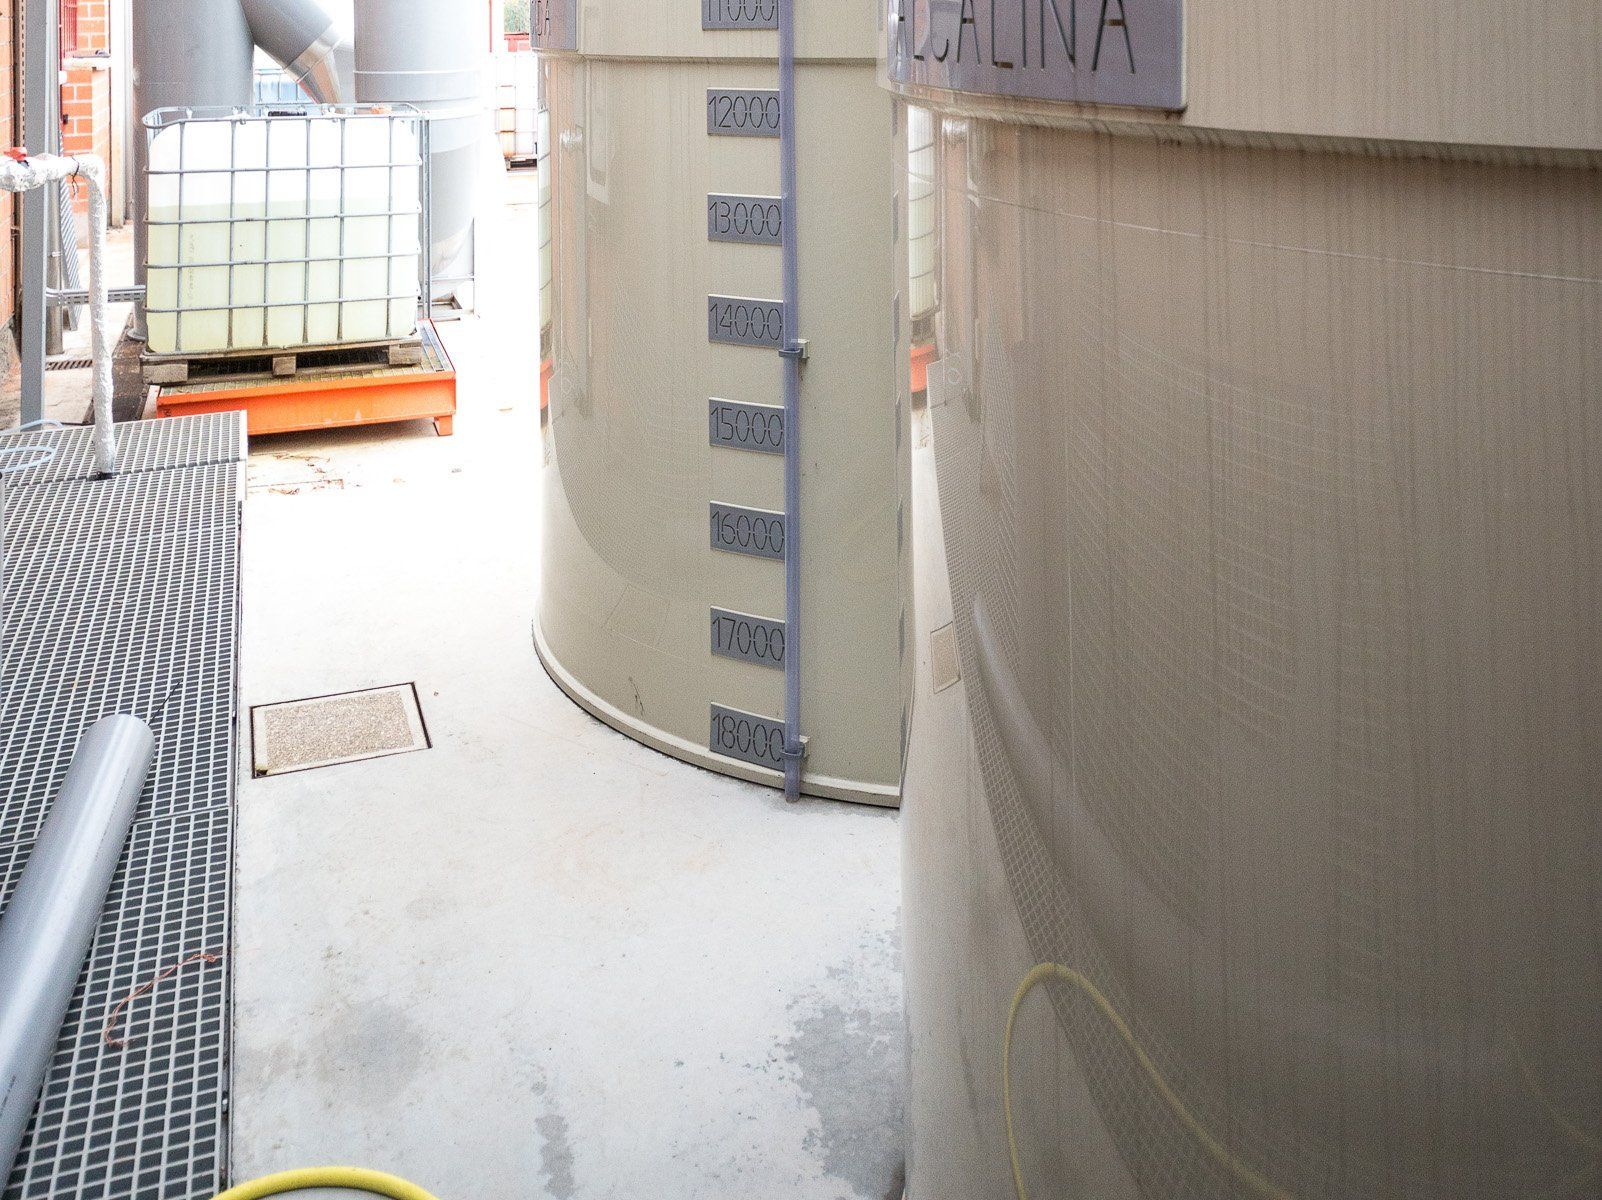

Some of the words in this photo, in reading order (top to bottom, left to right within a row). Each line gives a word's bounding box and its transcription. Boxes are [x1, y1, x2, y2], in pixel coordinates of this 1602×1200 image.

[708, 95, 781, 129] 12000
[709, 201, 782, 237] 13000
[709, 302, 782, 341] 14000
[711, 406, 784, 448] 15000
[712, 510, 786, 553] 16000
[712, 616, 786, 662] 17000
[713, 712, 786, 763] 18000
